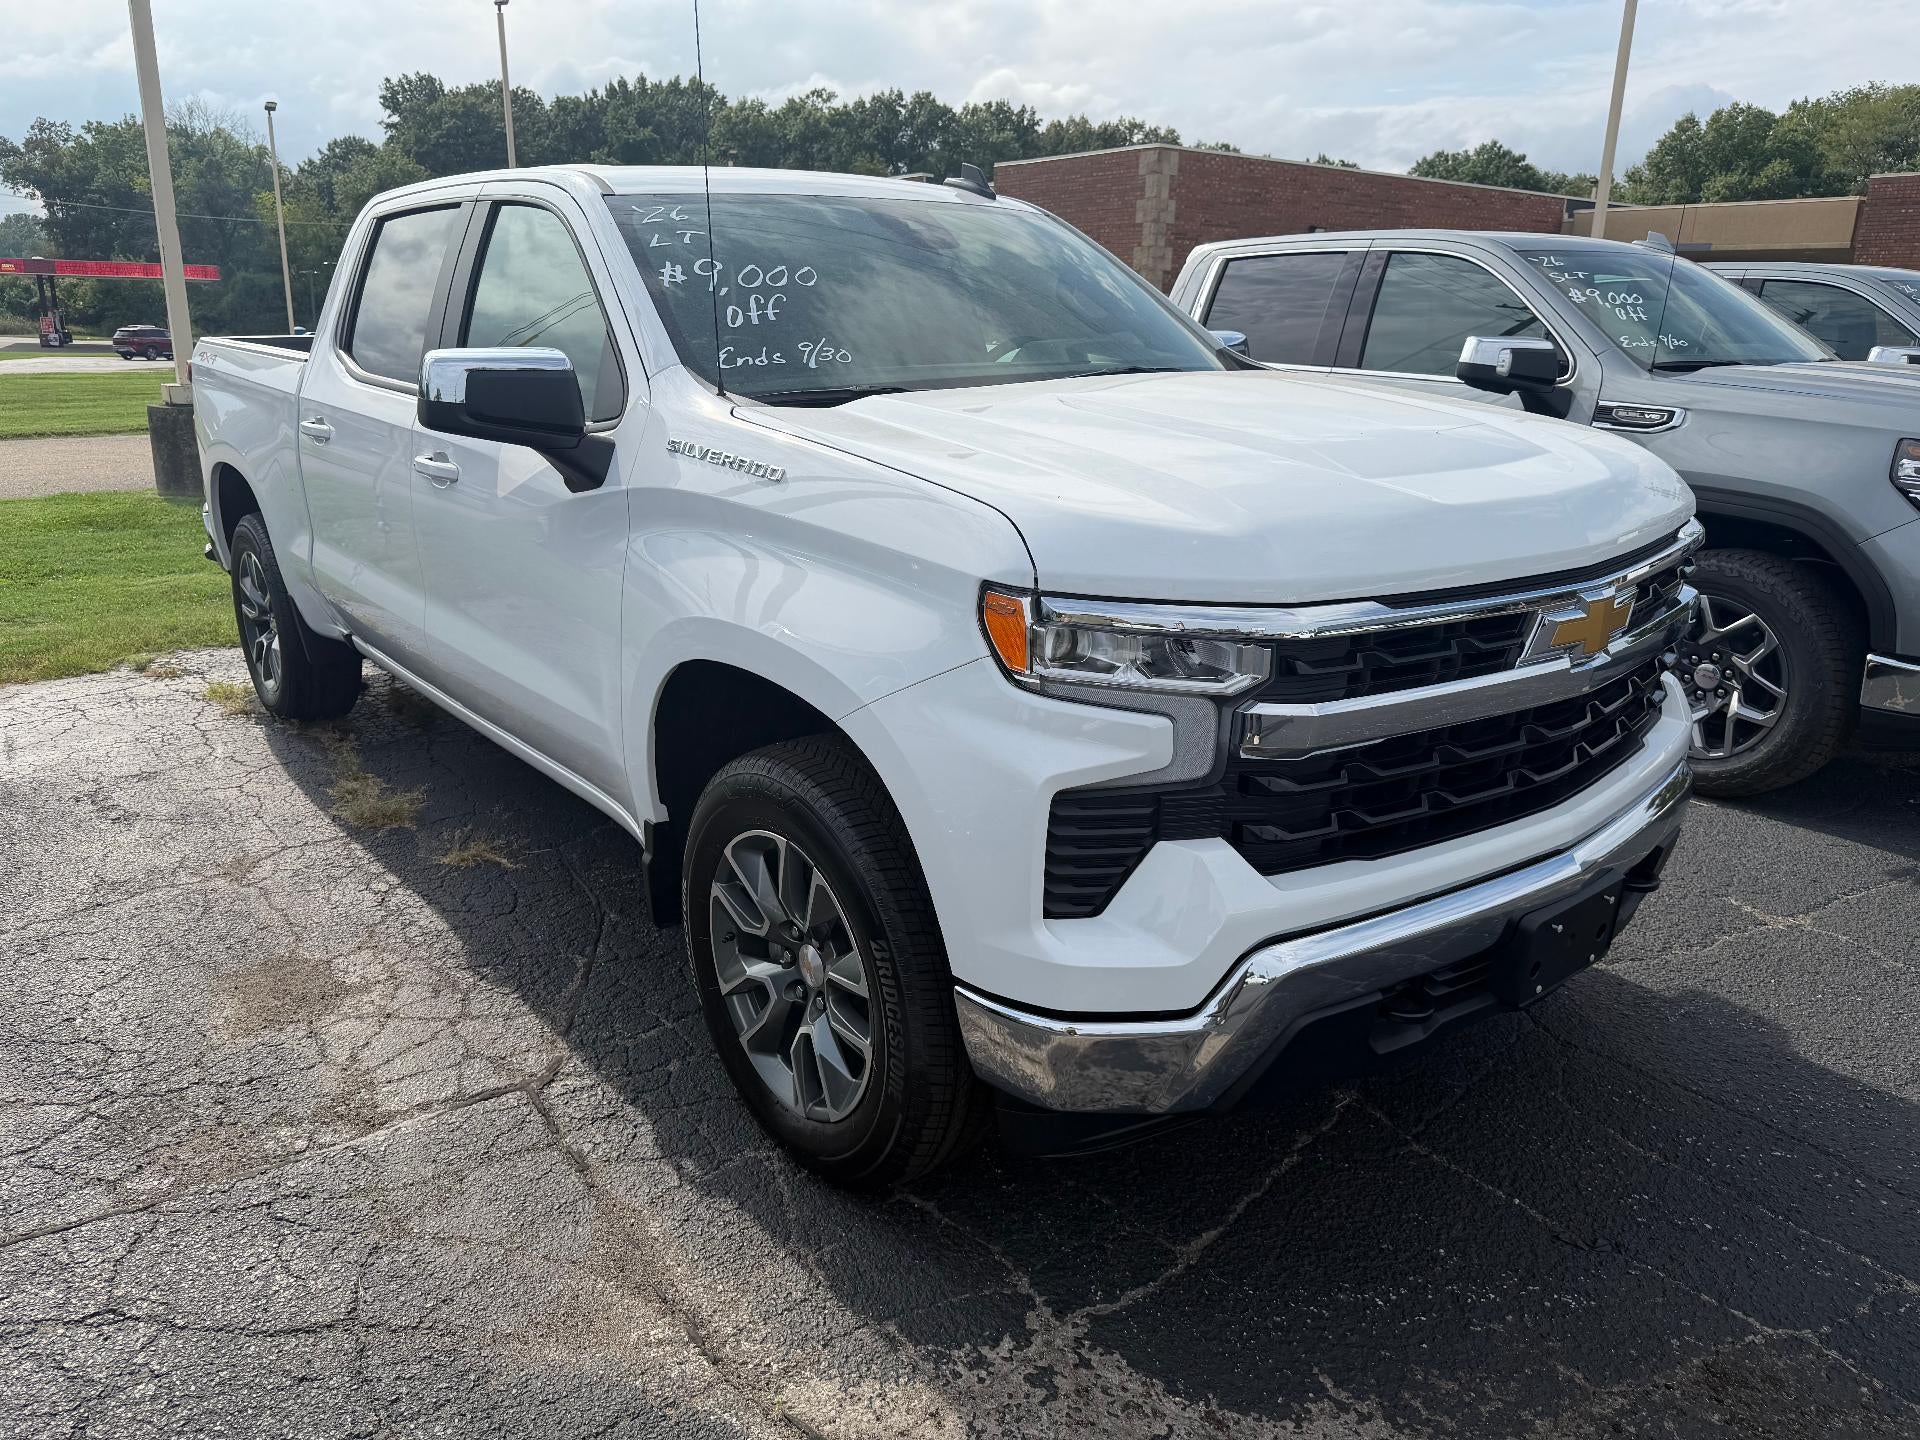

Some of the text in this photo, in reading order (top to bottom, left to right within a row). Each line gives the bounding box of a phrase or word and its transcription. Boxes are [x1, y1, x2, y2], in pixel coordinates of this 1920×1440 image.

[650, 230, 705, 247] LT
[1549, 272, 1589, 283] SLT
[1619, 333, 1688, 349] Ends 9/30
[717, 338, 852, 369] Ends 9/30
[666, 439, 785, 482] SILVERADO
[870, 939, 905, 1103] BRIDGESTONE
